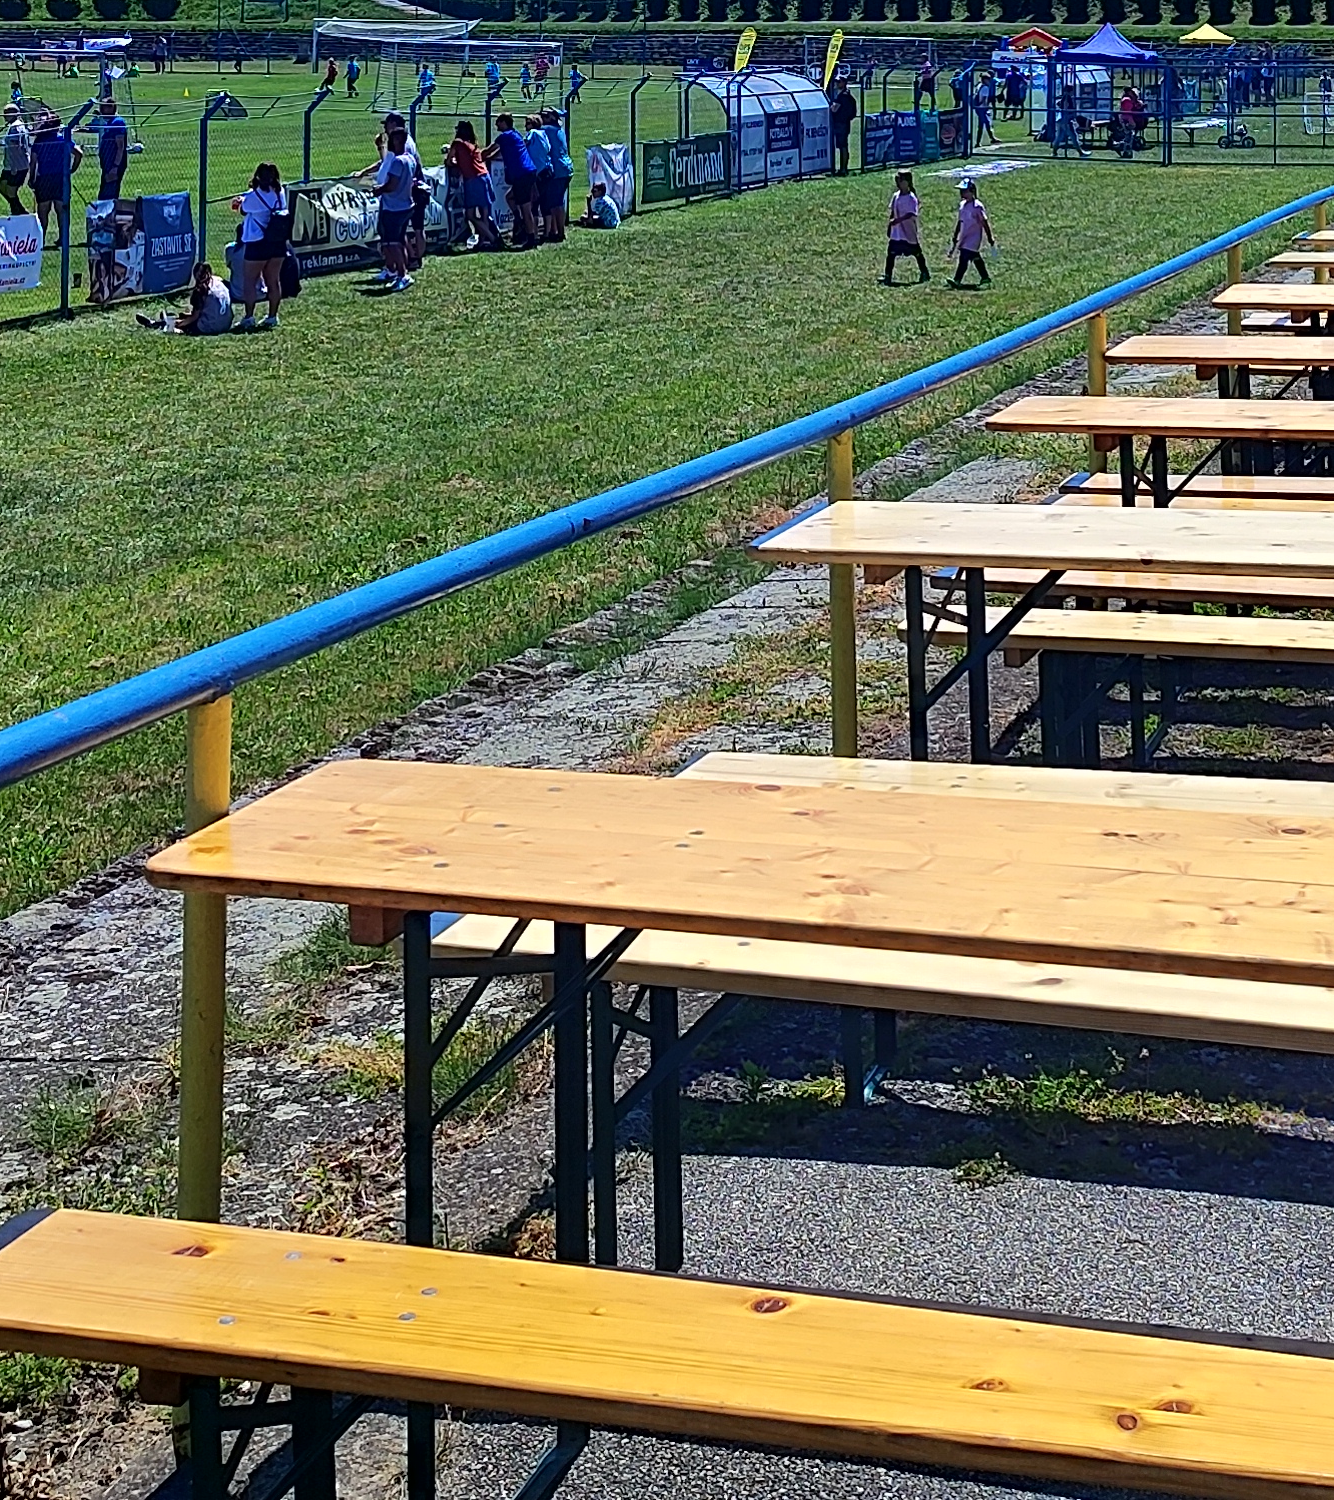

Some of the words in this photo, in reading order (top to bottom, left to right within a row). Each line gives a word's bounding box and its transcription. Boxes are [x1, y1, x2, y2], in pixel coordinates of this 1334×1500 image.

[669, 141, 724, 190] Ferdinand
[151, 235, 182, 257] ZASTAVTE
[184, 233, 192, 252] SE
[302, 253, 343, 269] reklama
